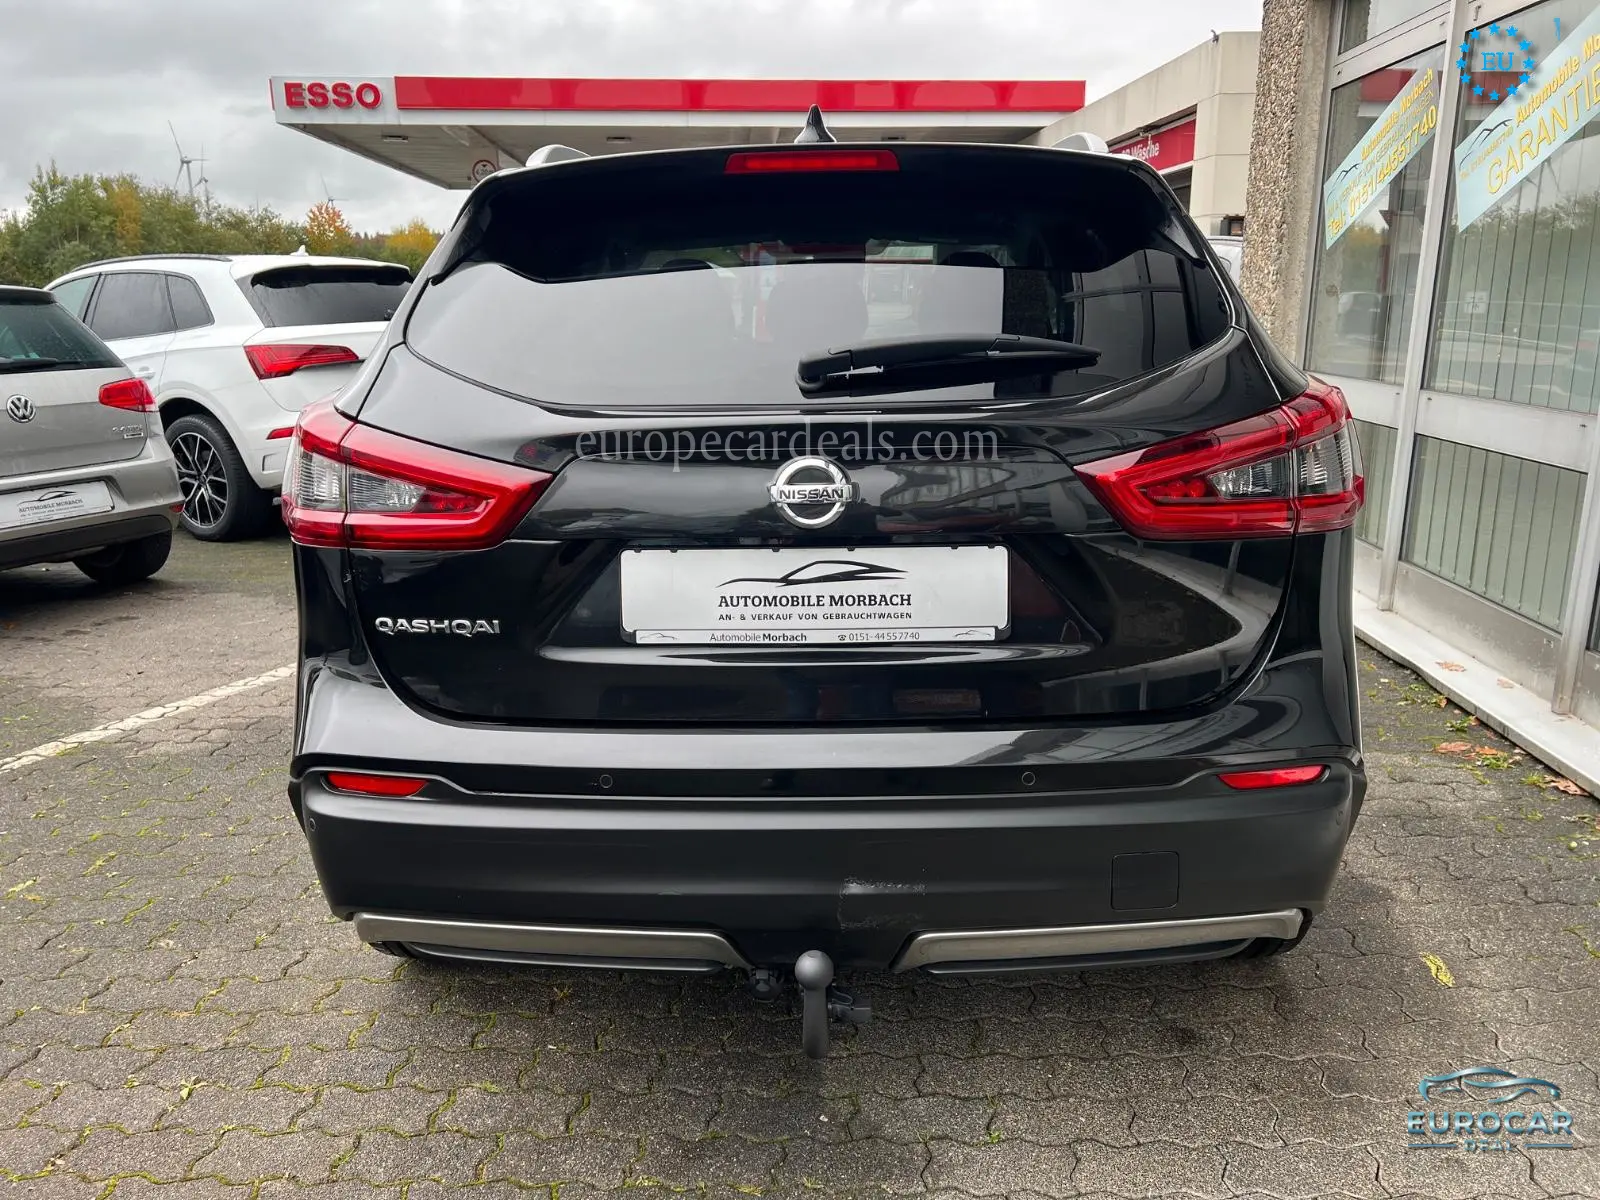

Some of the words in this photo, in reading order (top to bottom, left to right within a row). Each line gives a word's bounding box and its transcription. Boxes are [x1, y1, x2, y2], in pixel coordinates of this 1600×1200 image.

[283, 81, 383, 110] ESSO
[1515, 54, 1581, 127] Automobile
[1487, 62, 1600, 195] GARANTIE
[779, 488, 844, 500] NISSAN
[718, 595, 825, 607] AUTOMOBILE
[828, 594, 912, 607] MORBACH
[374, 616, 501, 638] QASHQAI
[718, 613, 736, 621] AN-
[739, 613, 747, 621] &
[751, 612, 794, 621] VERKAUF
[797, 612, 818, 621] VON
[822, 612, 912, 620] GEBRAUCHTWAGEN
